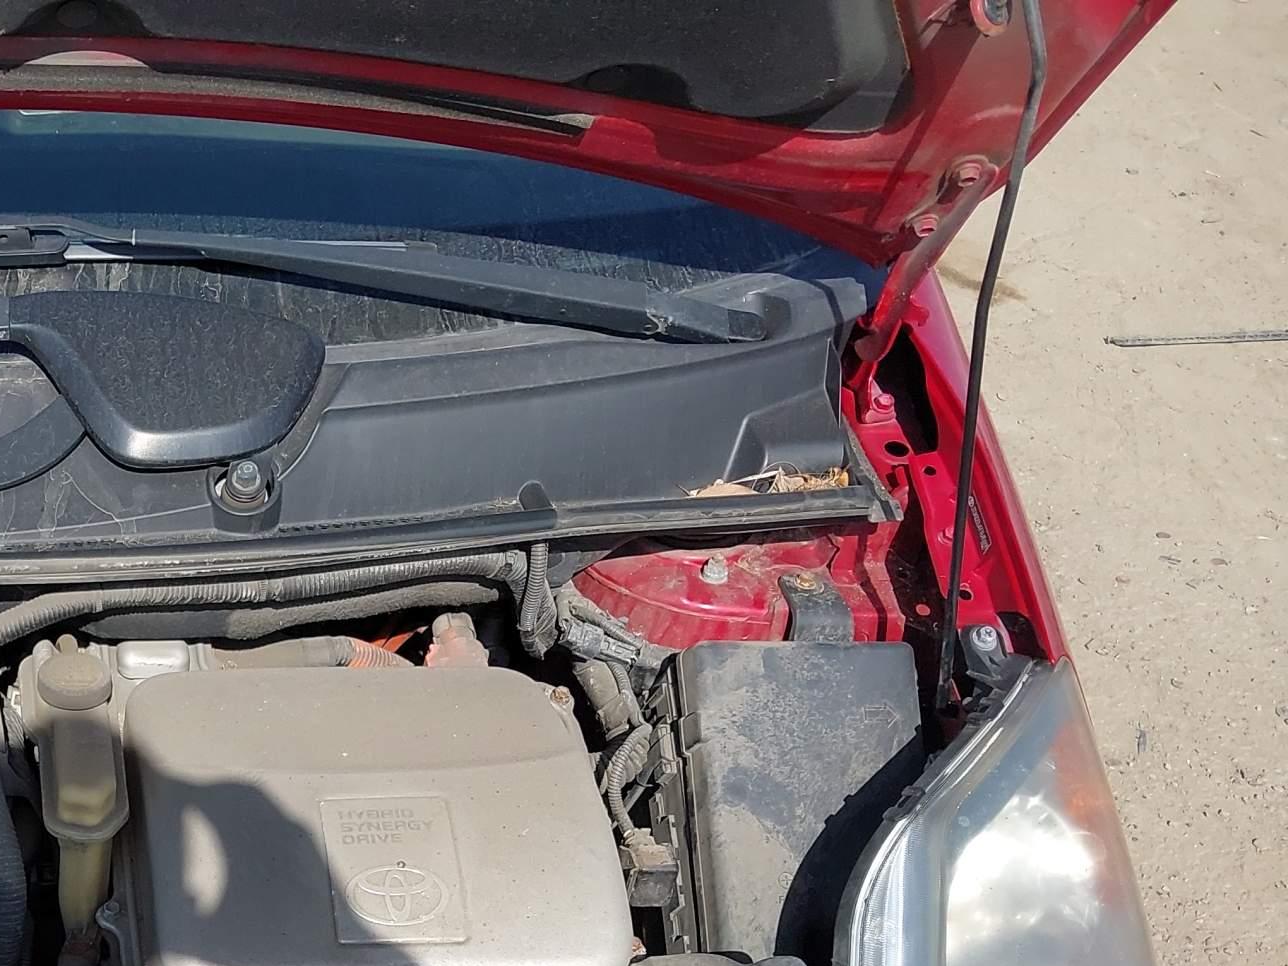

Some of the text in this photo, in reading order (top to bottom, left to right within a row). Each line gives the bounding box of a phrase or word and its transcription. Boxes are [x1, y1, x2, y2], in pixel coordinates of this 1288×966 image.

[338, 808, 415, 820] HYBRID
[340, 819, 434, 833] SYNERGY
[342, 833, 403, 845] DRIVE
